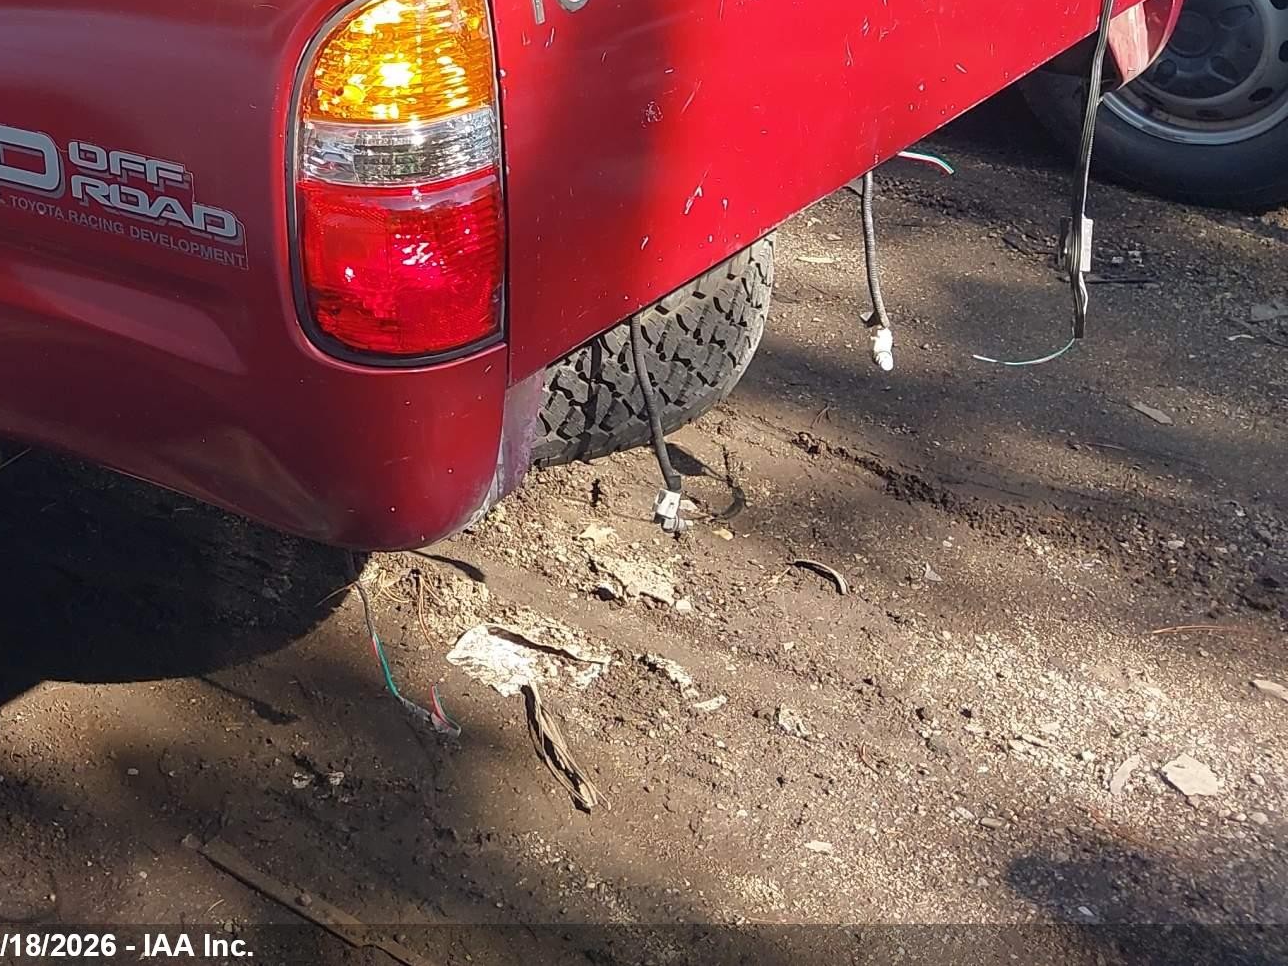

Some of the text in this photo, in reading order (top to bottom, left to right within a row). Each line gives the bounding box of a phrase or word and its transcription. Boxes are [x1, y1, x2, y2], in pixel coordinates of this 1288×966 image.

[68, 140, 188, 187] OFF
[9, 194, 248, 268] TOYOTA RACING DEVELOPMENT
[70, 175, 241, 241] ROAD
